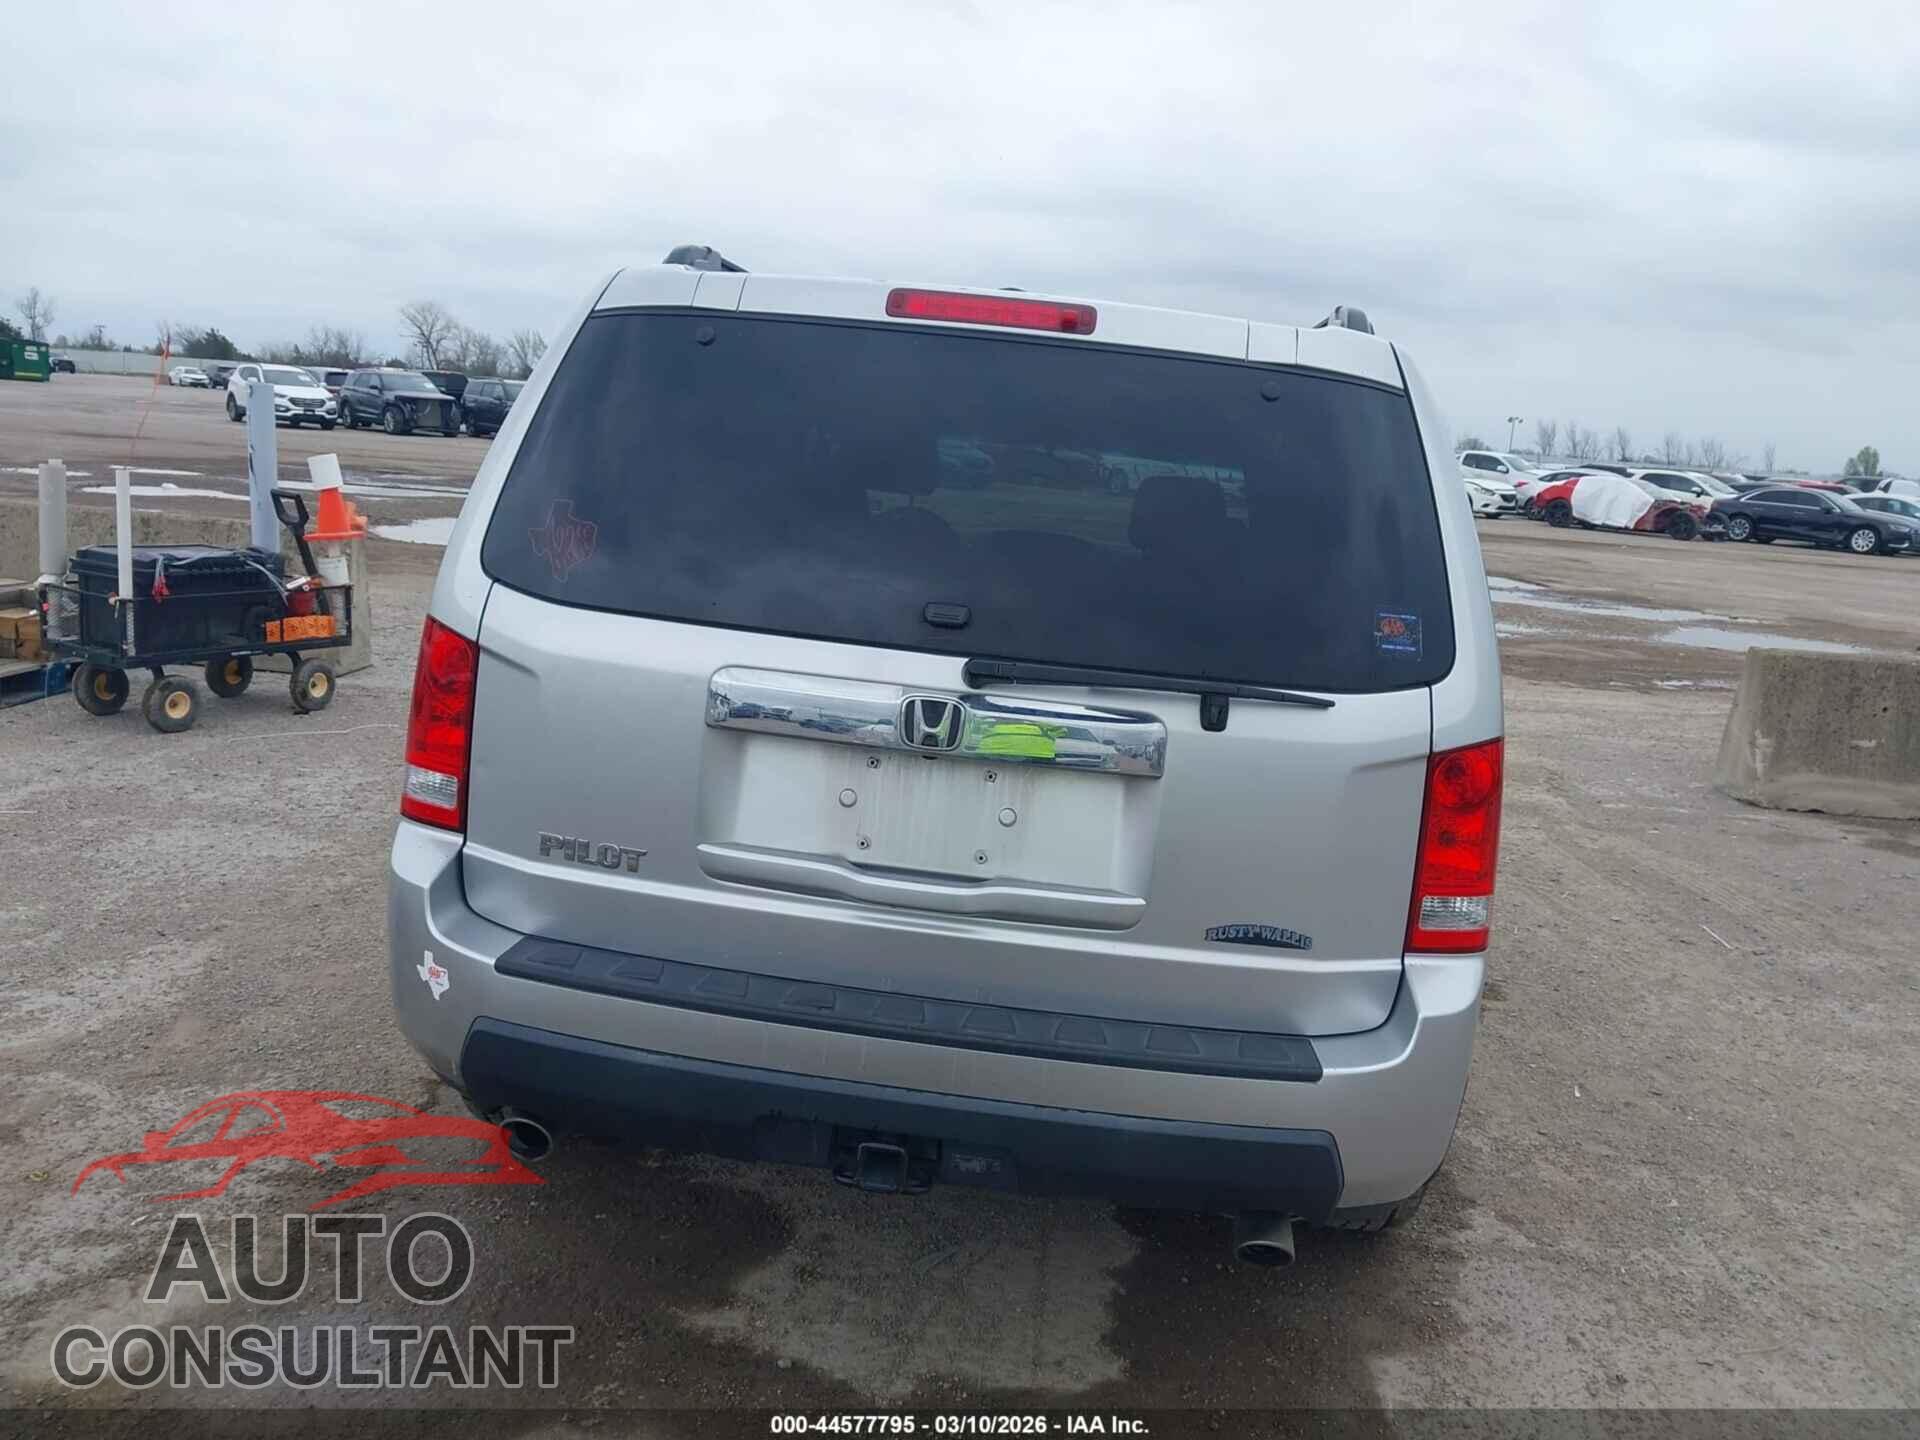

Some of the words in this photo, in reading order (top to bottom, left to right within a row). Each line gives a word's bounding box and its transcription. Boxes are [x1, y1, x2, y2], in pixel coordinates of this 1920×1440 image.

[538, 831, 648, 873] PILOT
[1205, 924, 1259, 942] RUSTY
[1259, 925, 1313, 950] WALLIS
